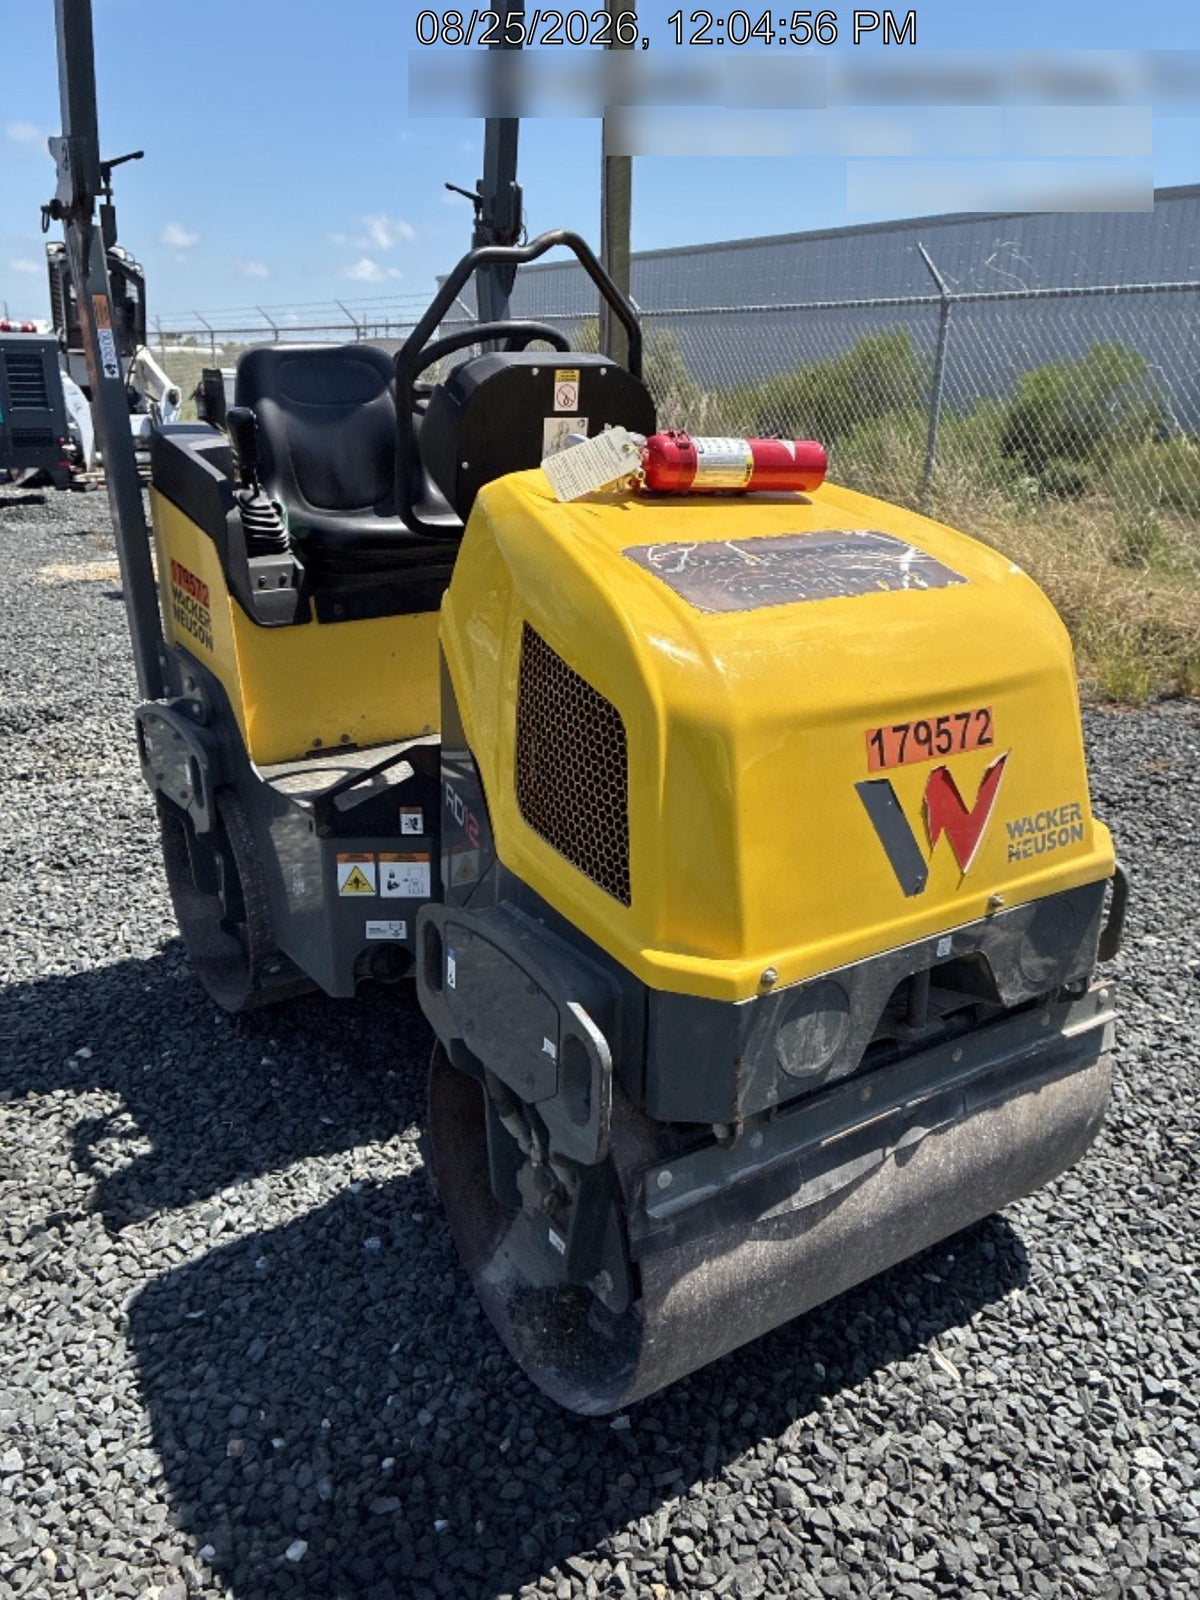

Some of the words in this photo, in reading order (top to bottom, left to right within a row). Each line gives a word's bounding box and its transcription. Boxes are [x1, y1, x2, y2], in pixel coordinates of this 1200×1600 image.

[171, 582, 212, 632] WACKER
[173, 603, 214, 653] NEUSON
[870, 708, 993, 767] 179572
[1005, 802, 1082, 840] WACKER
[1007, 823, 1084, 863] NEUSON
